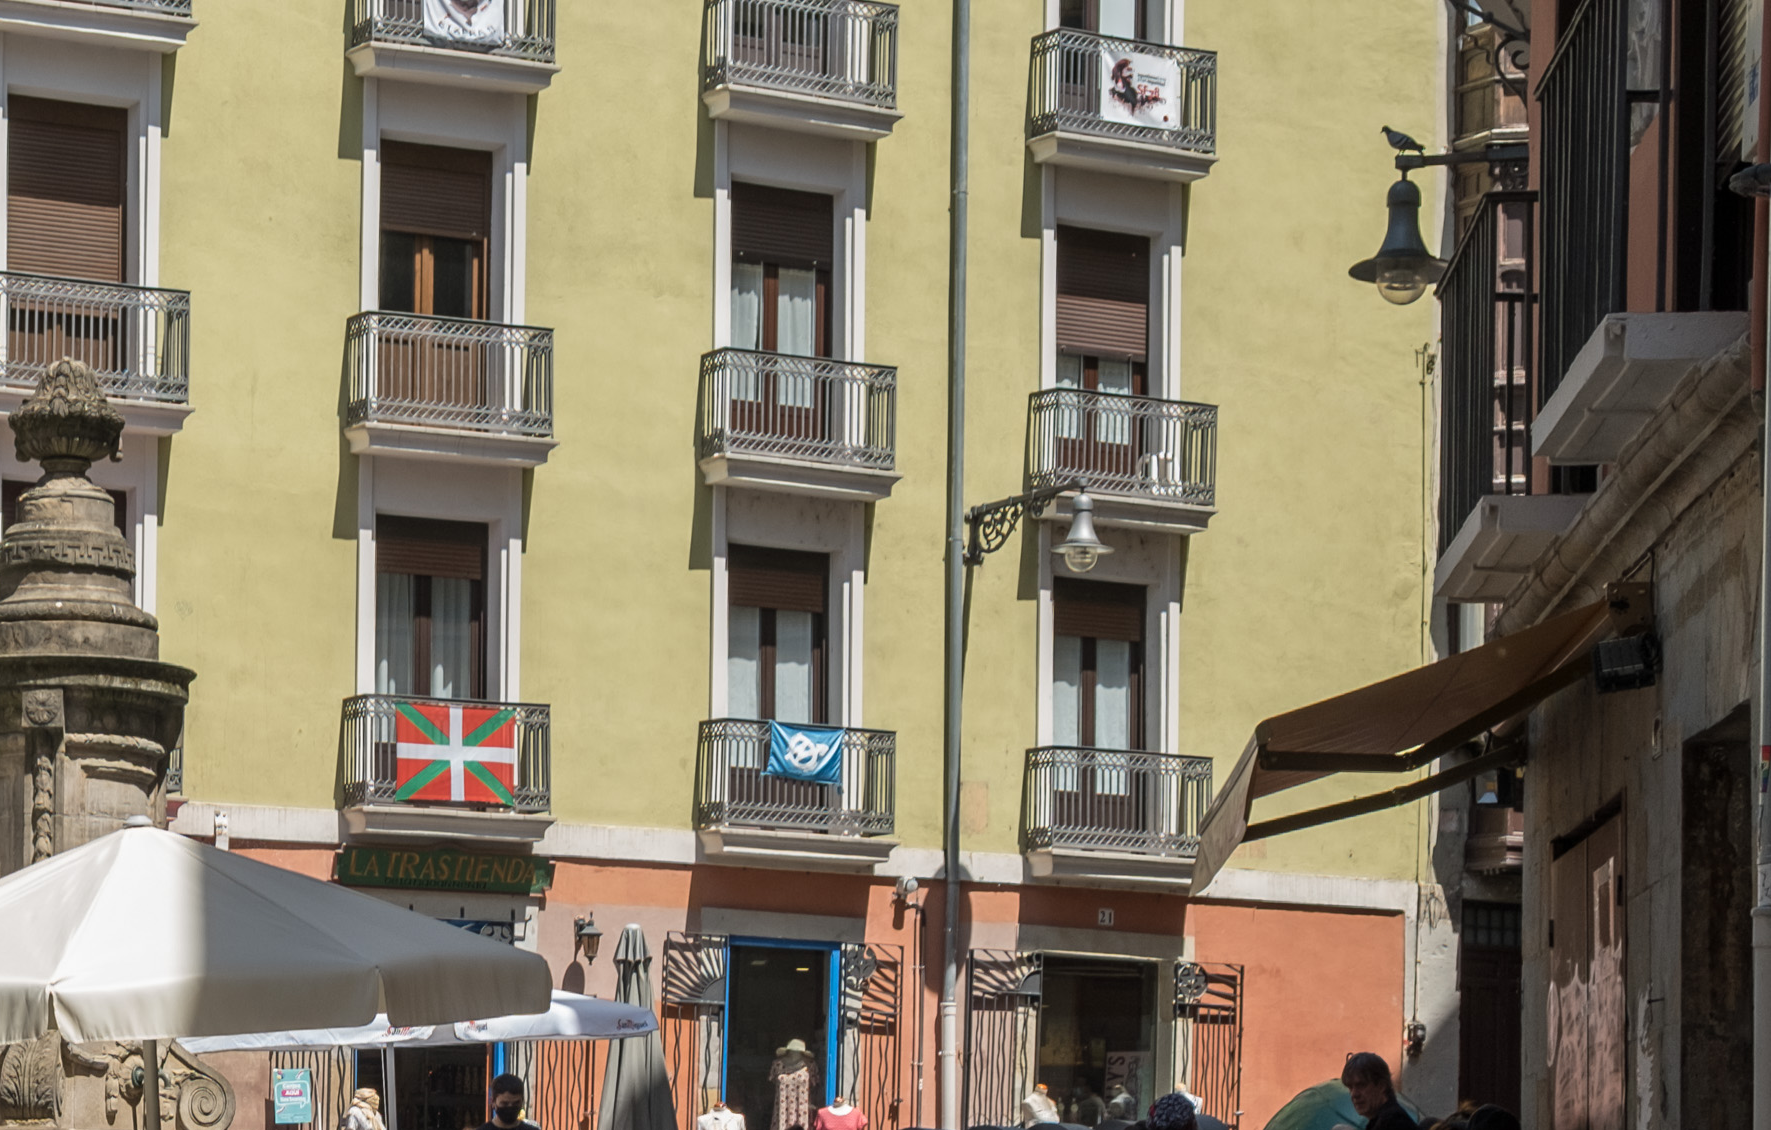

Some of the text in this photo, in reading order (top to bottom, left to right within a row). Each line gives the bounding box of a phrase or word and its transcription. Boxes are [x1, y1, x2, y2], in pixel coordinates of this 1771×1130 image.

[349, 849, 536, 884] LA TRASTIENDA
[1100, 910, 1112, 924] 21
